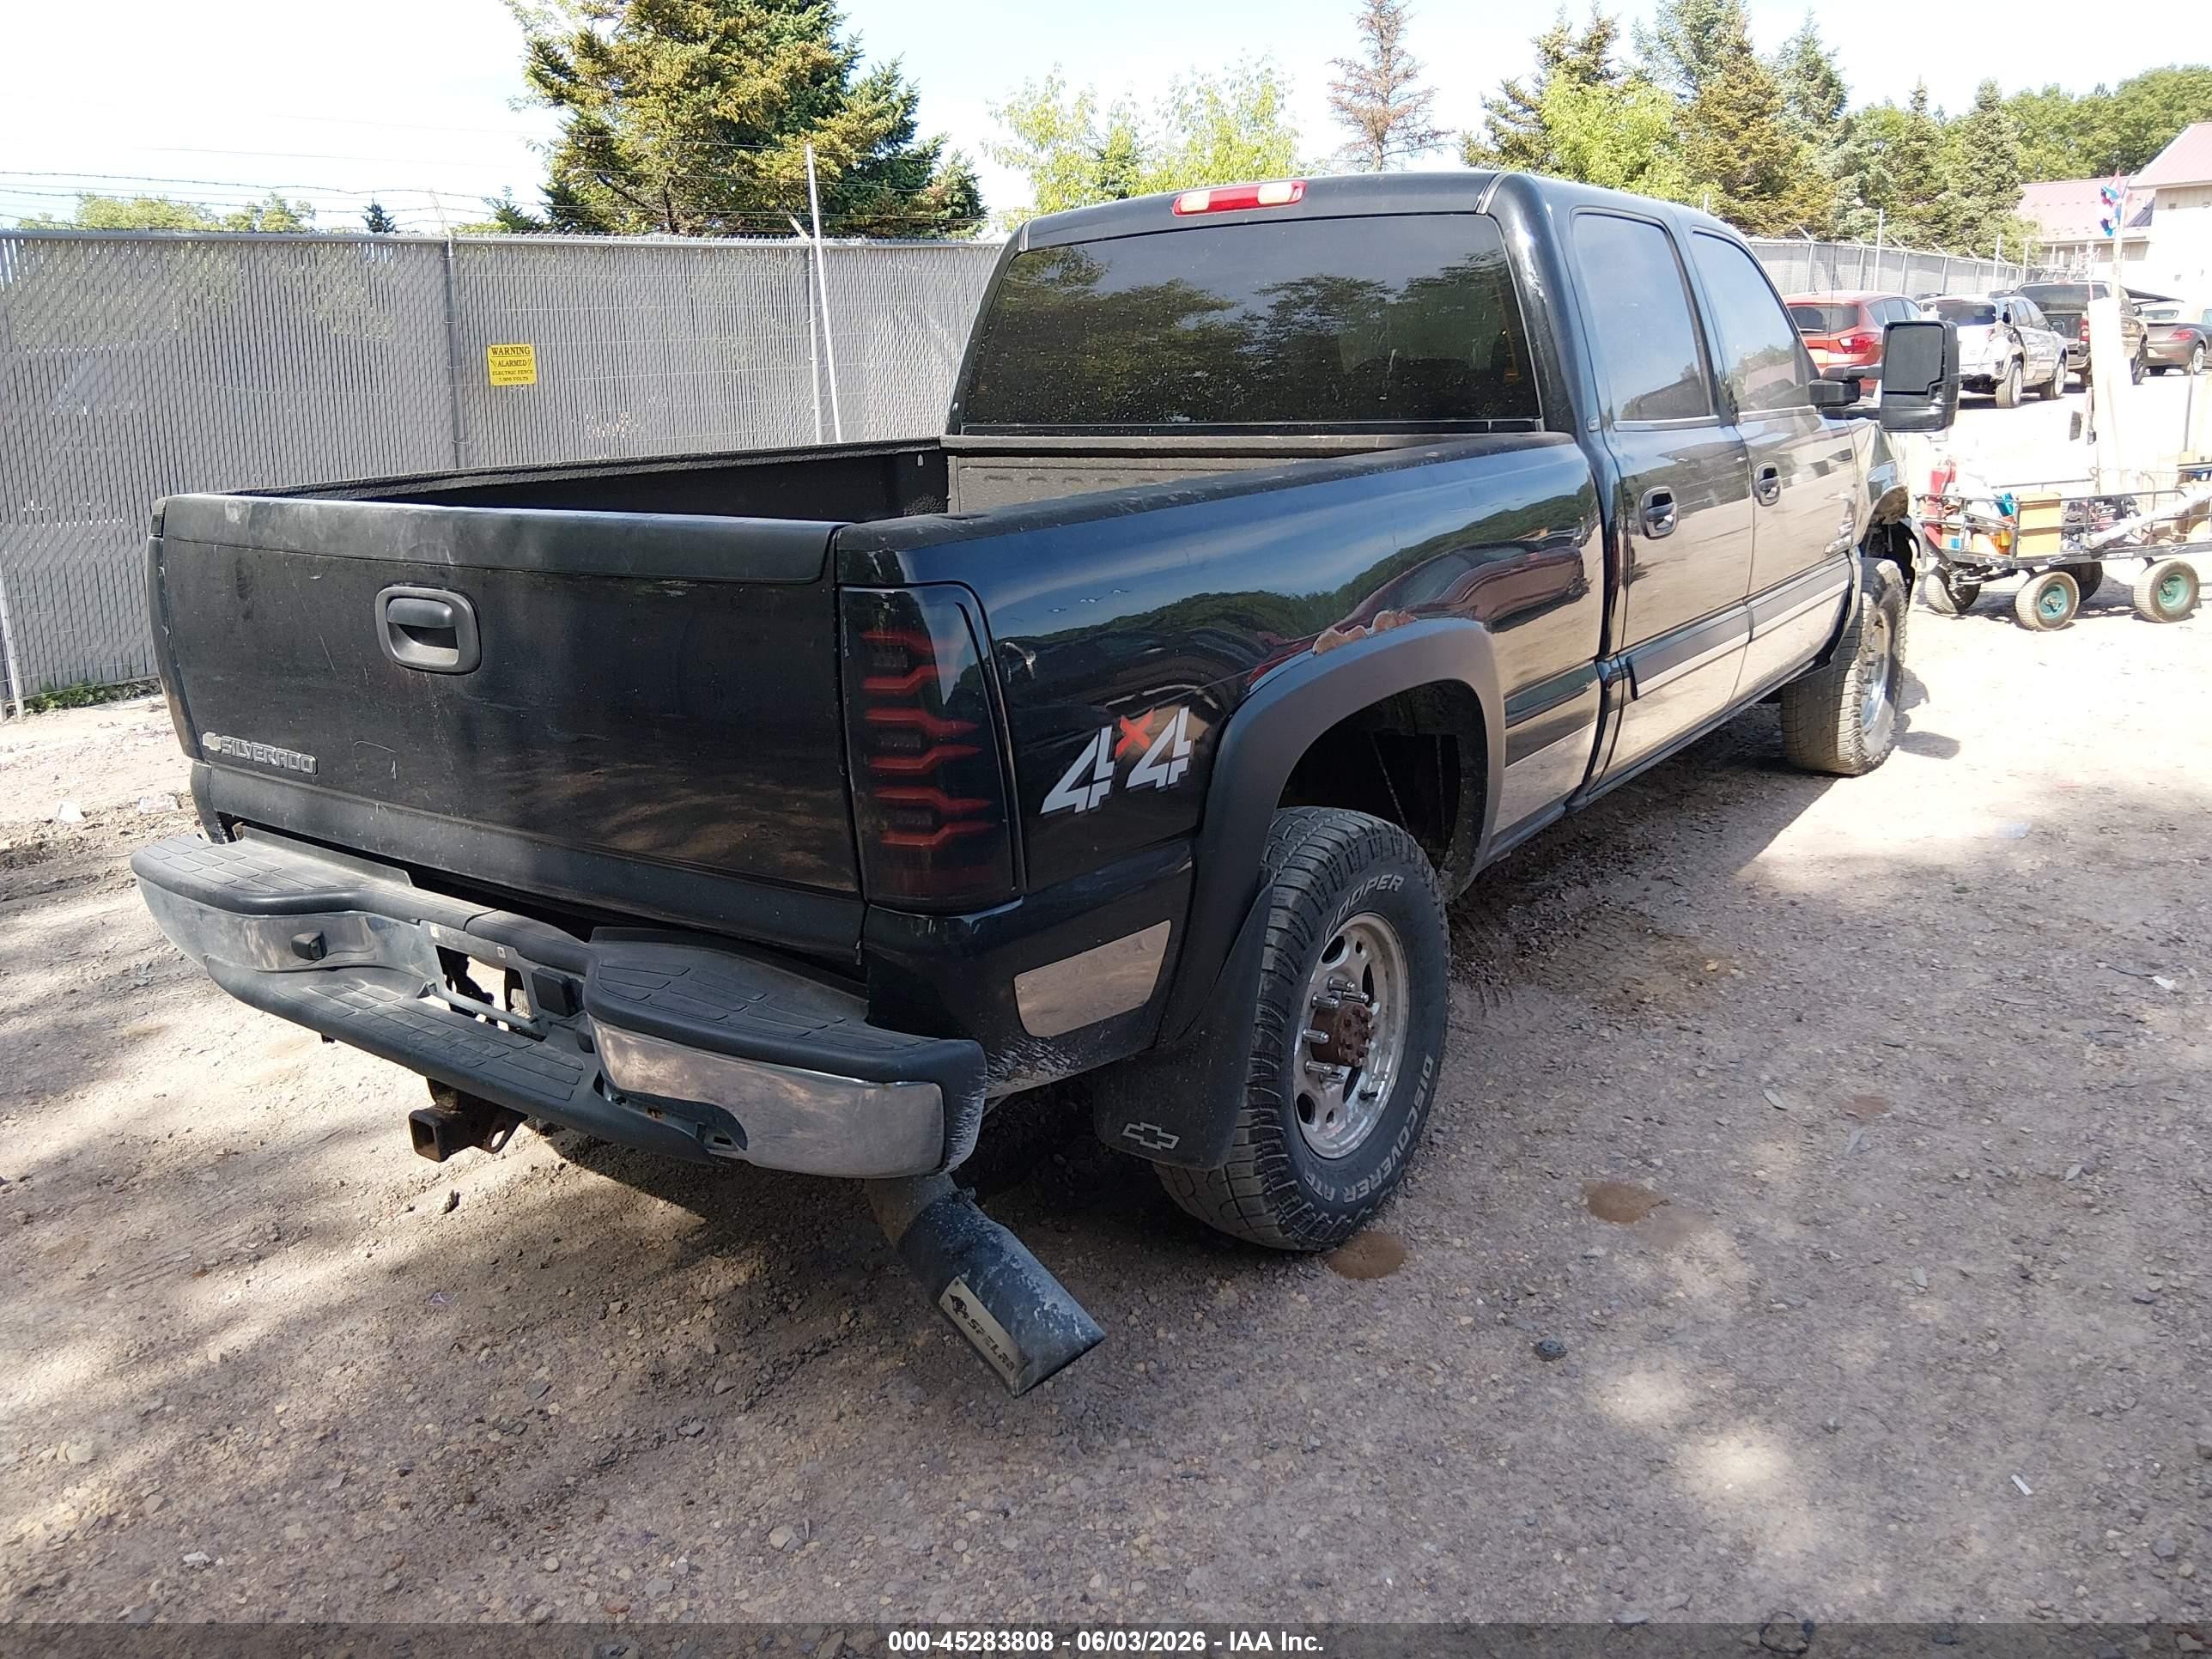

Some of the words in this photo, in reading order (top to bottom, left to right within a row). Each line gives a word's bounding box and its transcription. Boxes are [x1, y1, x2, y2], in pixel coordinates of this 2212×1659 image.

[491, 346, 531, 356] WARNING
[497, 359, 527, 368] ALARMED
[220, 736, 317, 775] SILVERADO
[1324, 873, 1405, 945] COOPER
[1343, 1054, 1434, 1203] DISCOVERER
